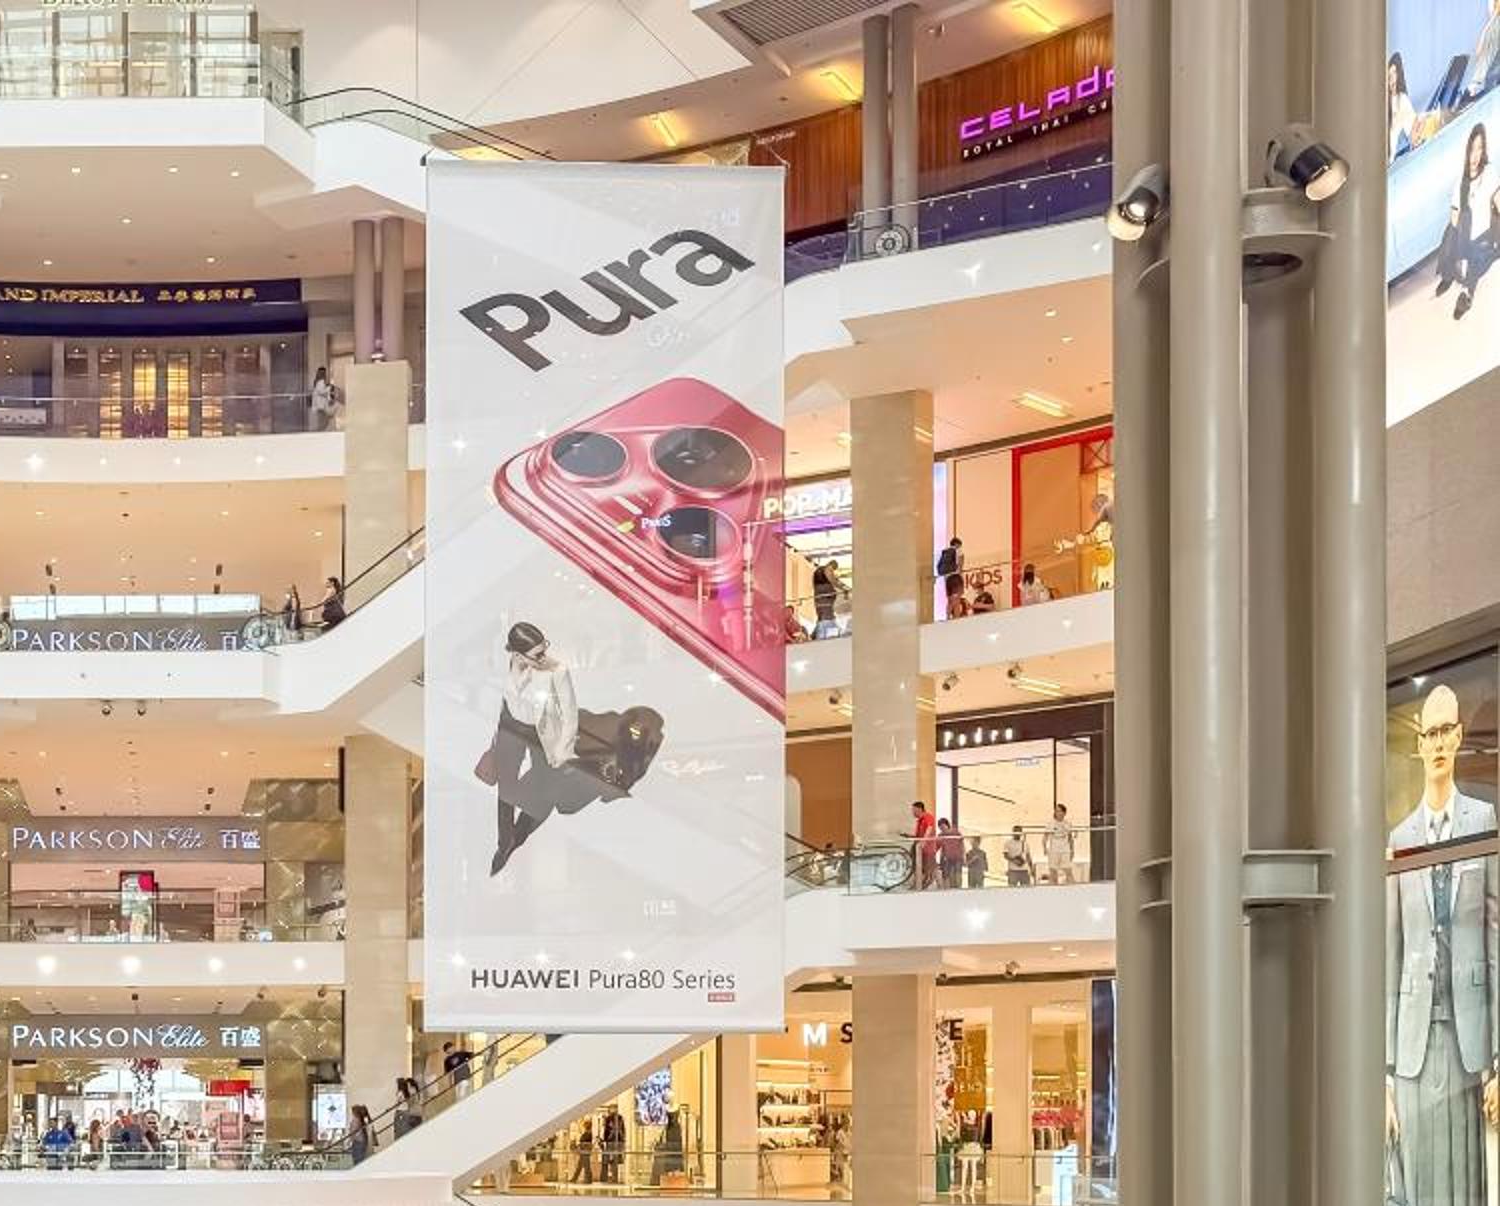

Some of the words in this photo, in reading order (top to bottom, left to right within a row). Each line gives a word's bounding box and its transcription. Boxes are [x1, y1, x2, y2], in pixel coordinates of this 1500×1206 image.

[41, 287, 145, 303] IMPERIAL
[459, 229, 756, 373] Pura
[13, 628, 153, 651] PARKSON
[13, 827, 153, 849] PARKSON
[471, 969, 580, 989] HUAWEI
[588, 968, 666, 990] Pura80
[672, 968, 736, 989] Series
[13, 1024, 153, 1048] PARKSON
[156, 1023, 209, 1048] Elite
